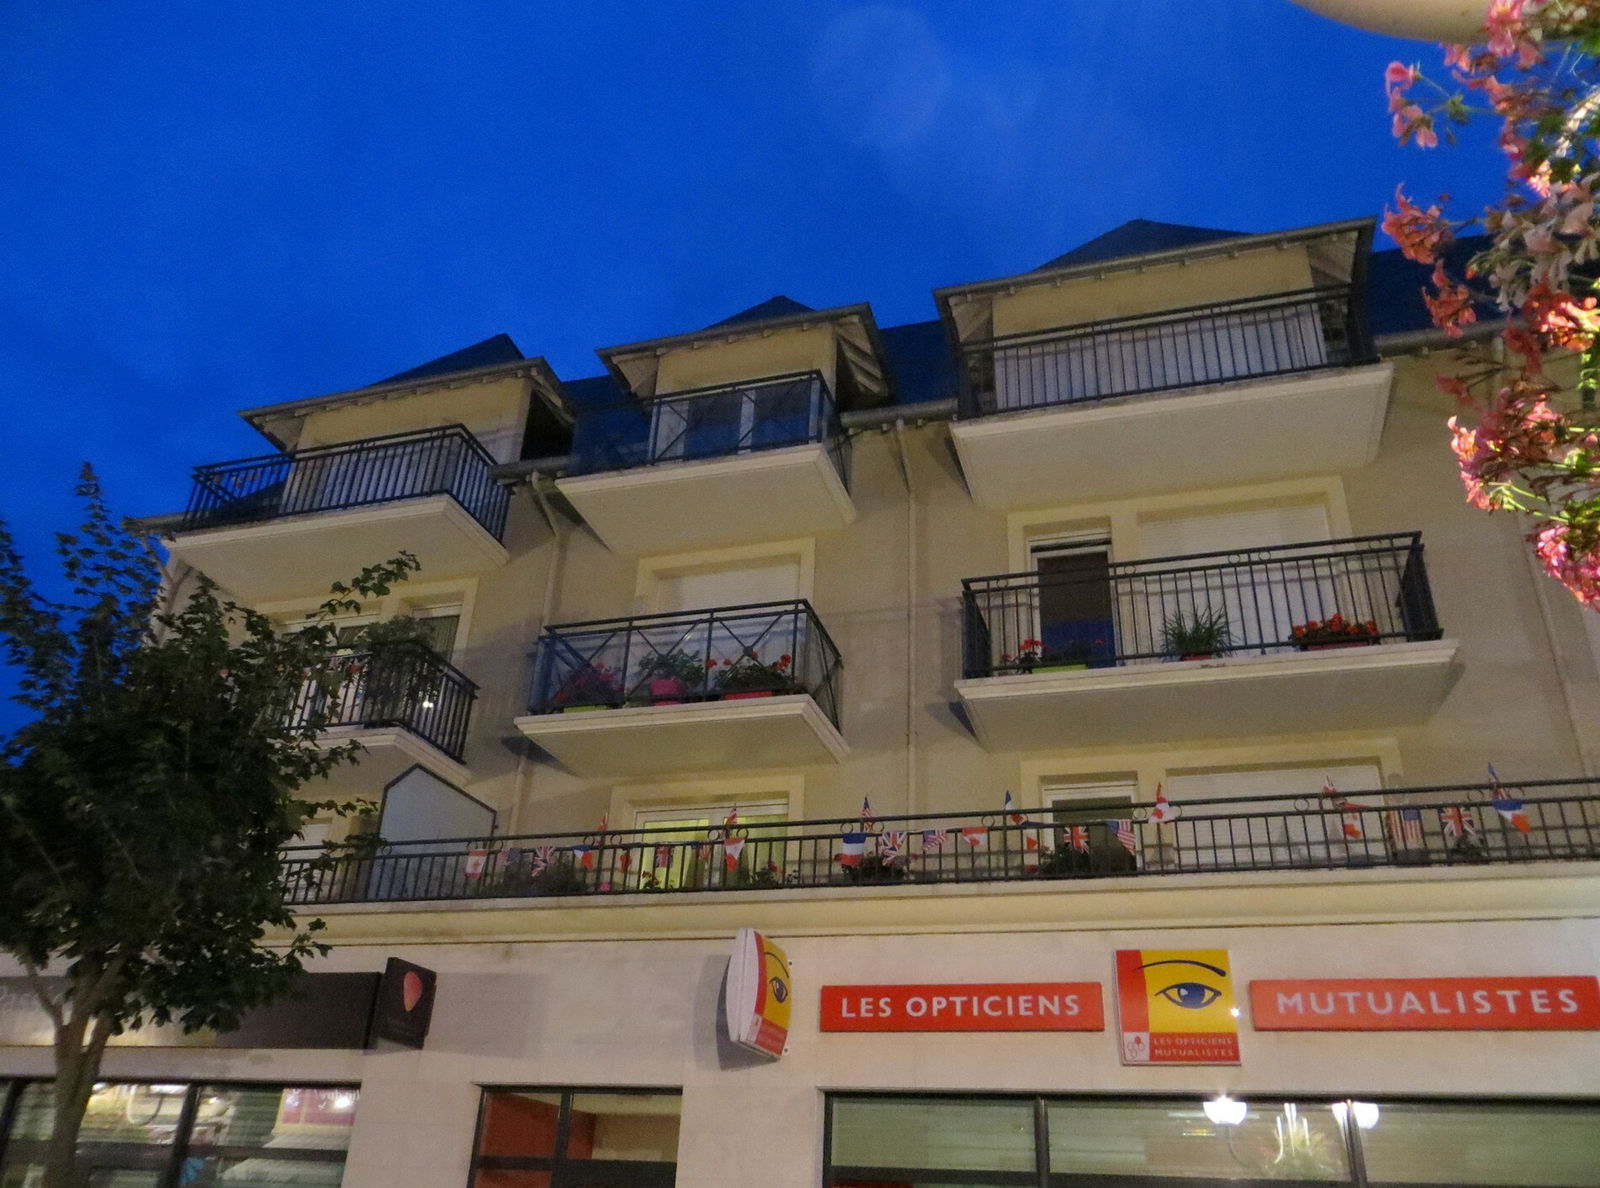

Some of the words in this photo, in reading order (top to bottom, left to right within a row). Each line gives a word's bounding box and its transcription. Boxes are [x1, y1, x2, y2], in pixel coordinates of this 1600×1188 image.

[840, 997, 892, 1018] LES
[905, 994, 1080, 1017] OPTICIENS
[1275, 989, 1579, 1015] MUTUALISTES
[1153, 1037, 1172, 1046] LES
[1175, 1037, 1233, 1046] OPTICIENS
[1154, 1048, 1234, 1057] MUTUALISTES
